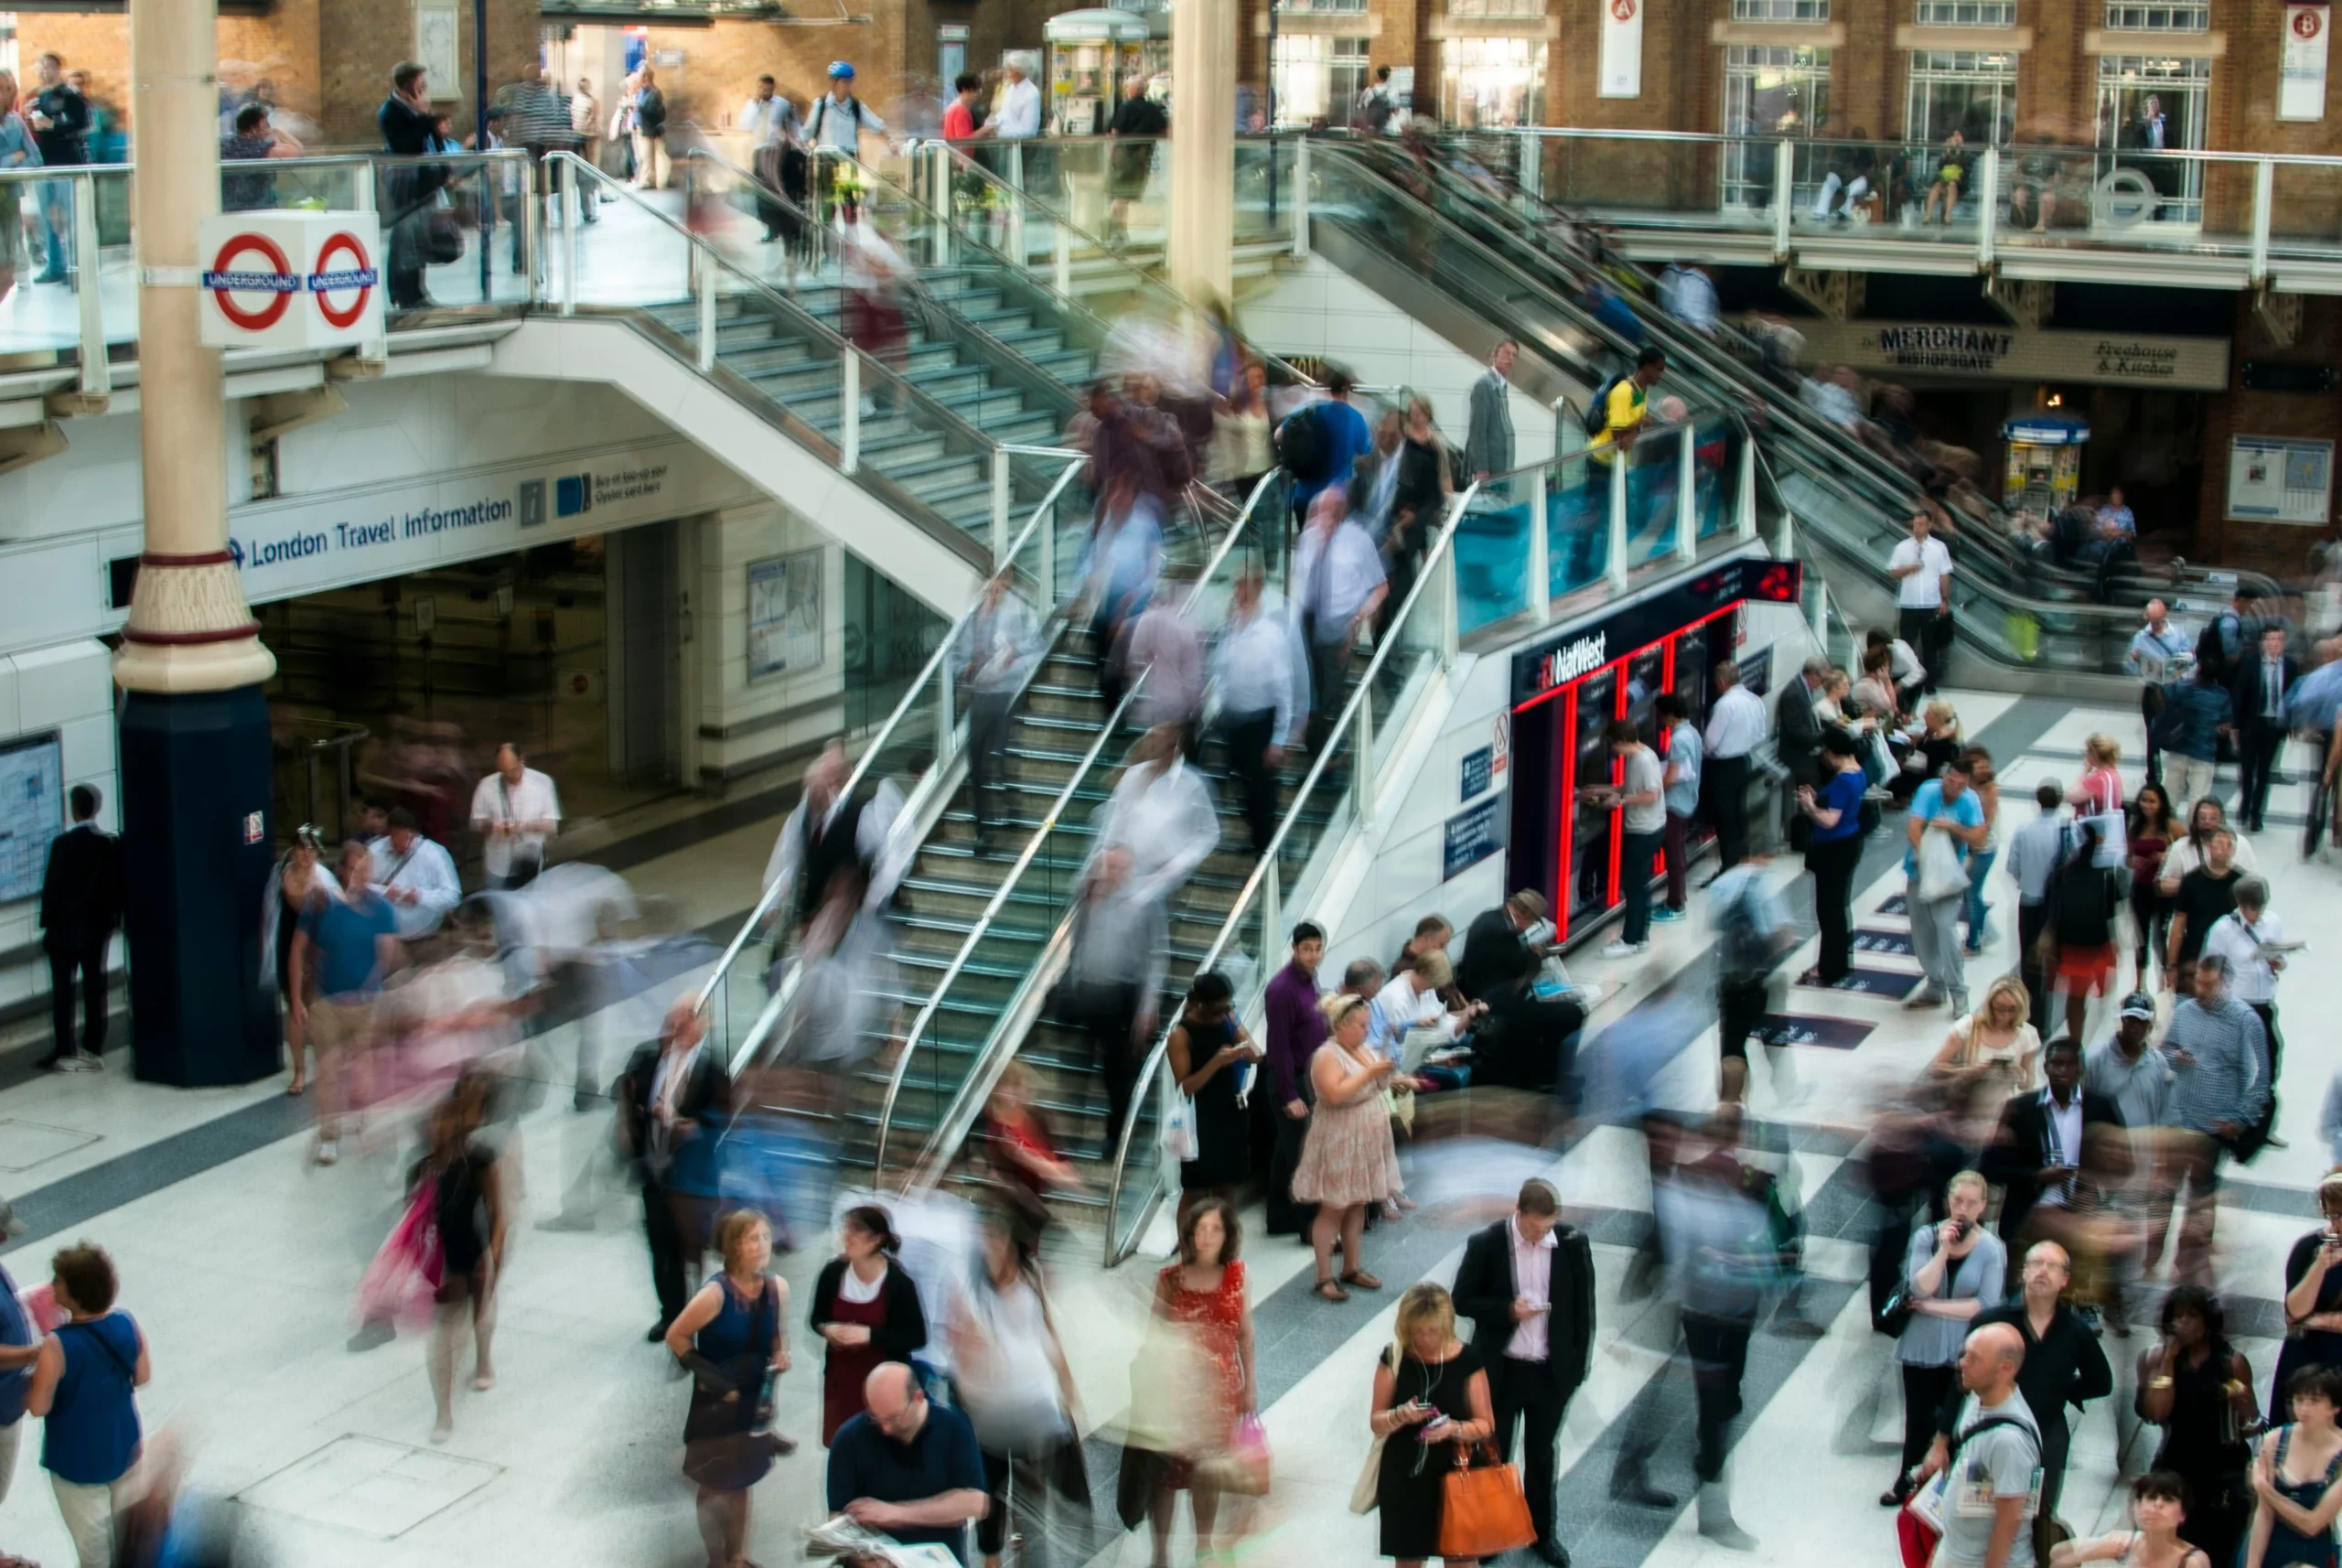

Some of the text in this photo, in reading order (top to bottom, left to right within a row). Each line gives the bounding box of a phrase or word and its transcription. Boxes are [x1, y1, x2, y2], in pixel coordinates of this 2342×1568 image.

[1616, 0, 1631, 16] A
[2301, 14, 2315, 33] B
[209, 274, 296, 288] UNDERGROUND
[312, 272, 373, 287] UNDERGROUND
[1881, 326, 2012, 356] MERCHANT
[1897, 352, 1993, 369] BISHOPSGATE
[252, 499, 511, 566] London Travel Information
[1555, 629, 1606, 684] NatWest
